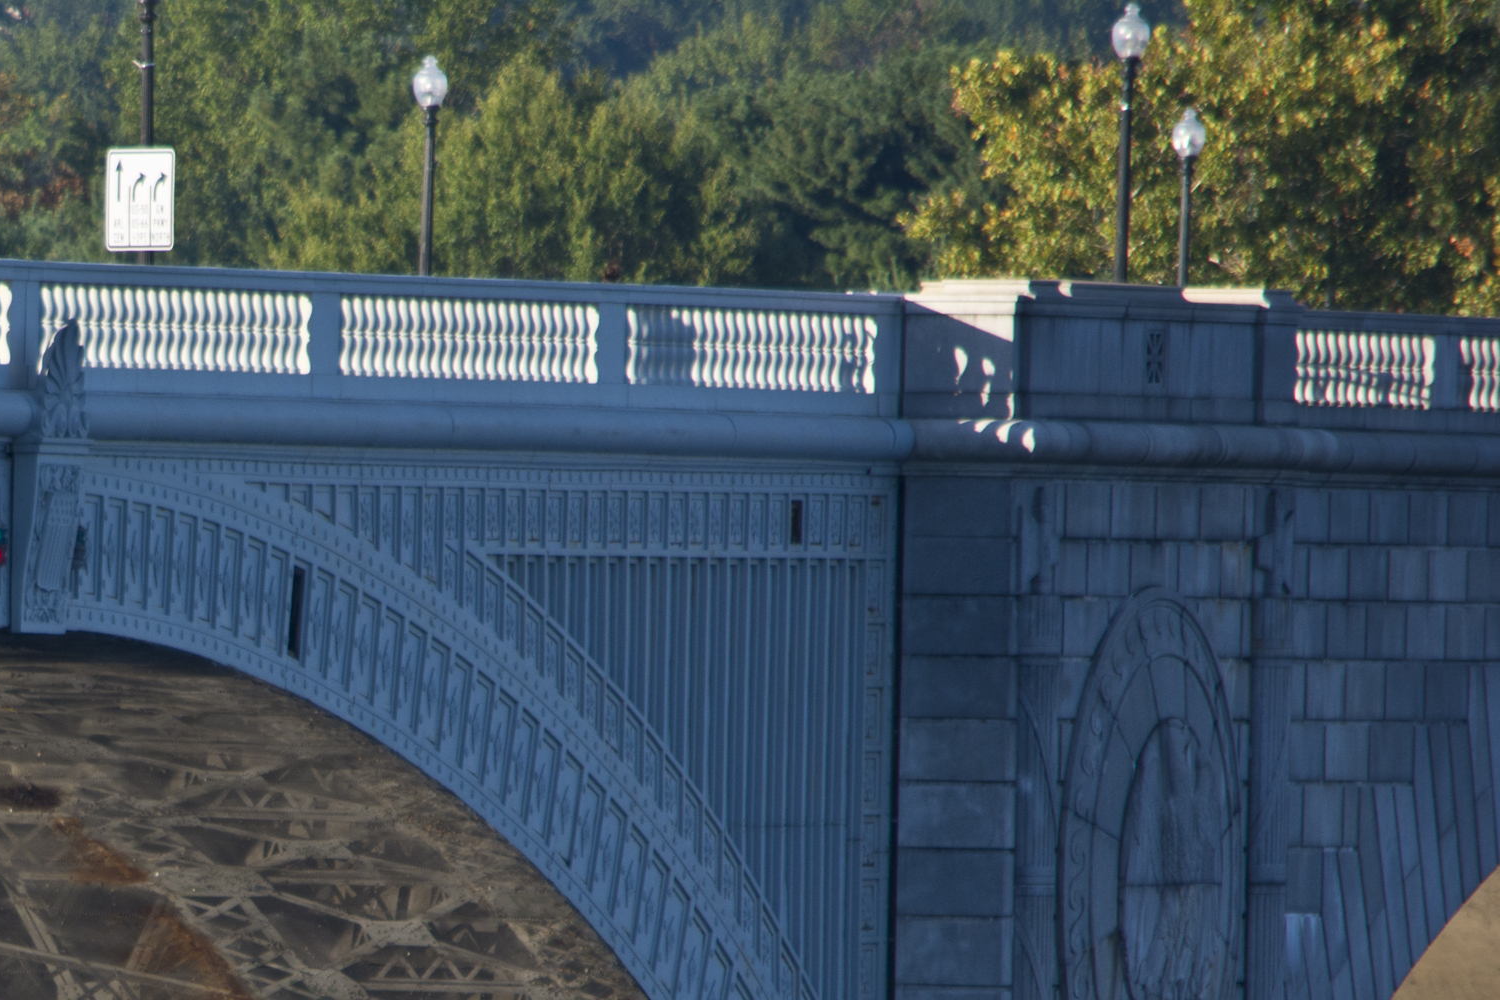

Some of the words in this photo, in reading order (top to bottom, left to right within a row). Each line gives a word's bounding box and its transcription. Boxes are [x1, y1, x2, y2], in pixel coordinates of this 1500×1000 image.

[113, 218, 124, 229] ARL
[153, 218, 168, 229] PKWY
[151, 232, 171, 244] NORTH
